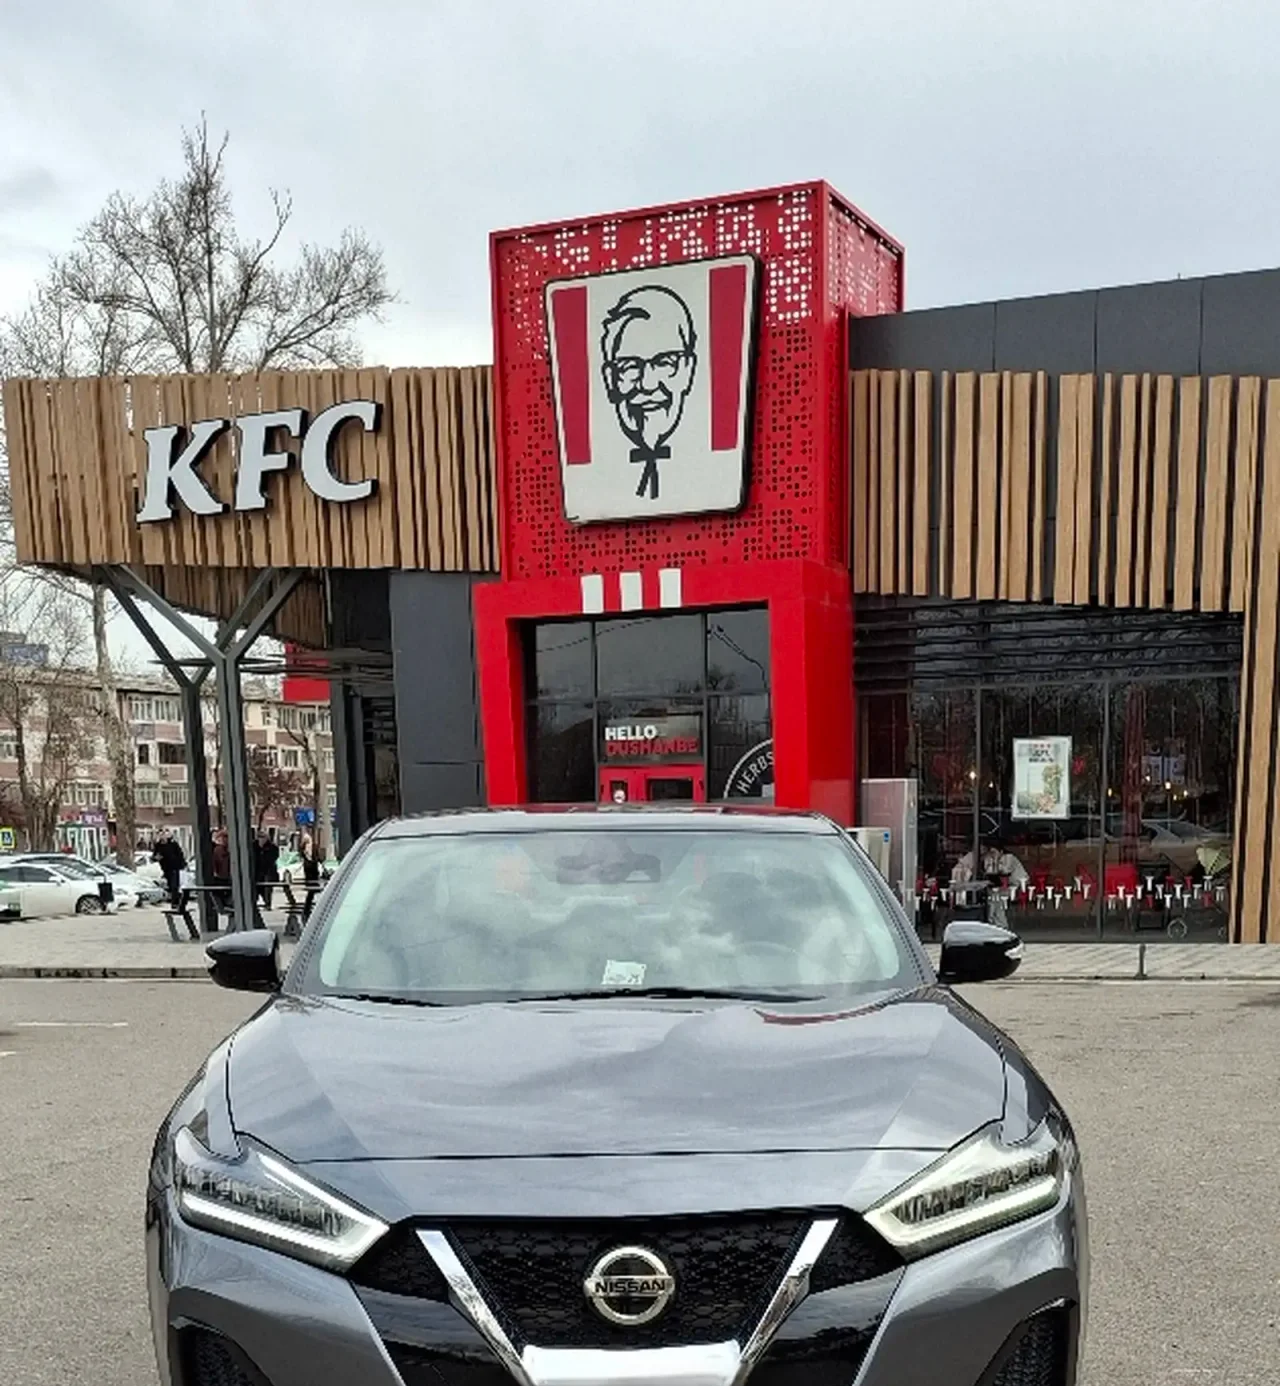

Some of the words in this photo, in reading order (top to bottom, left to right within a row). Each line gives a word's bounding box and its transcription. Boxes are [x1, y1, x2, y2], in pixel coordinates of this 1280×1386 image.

[136, 399, 381, 525] KFC
[605, 725, 658, 741] HELLO
[606, 737, 698, 757] DUSHANBE
[595, 1279, 665, 1293] NISSAN
